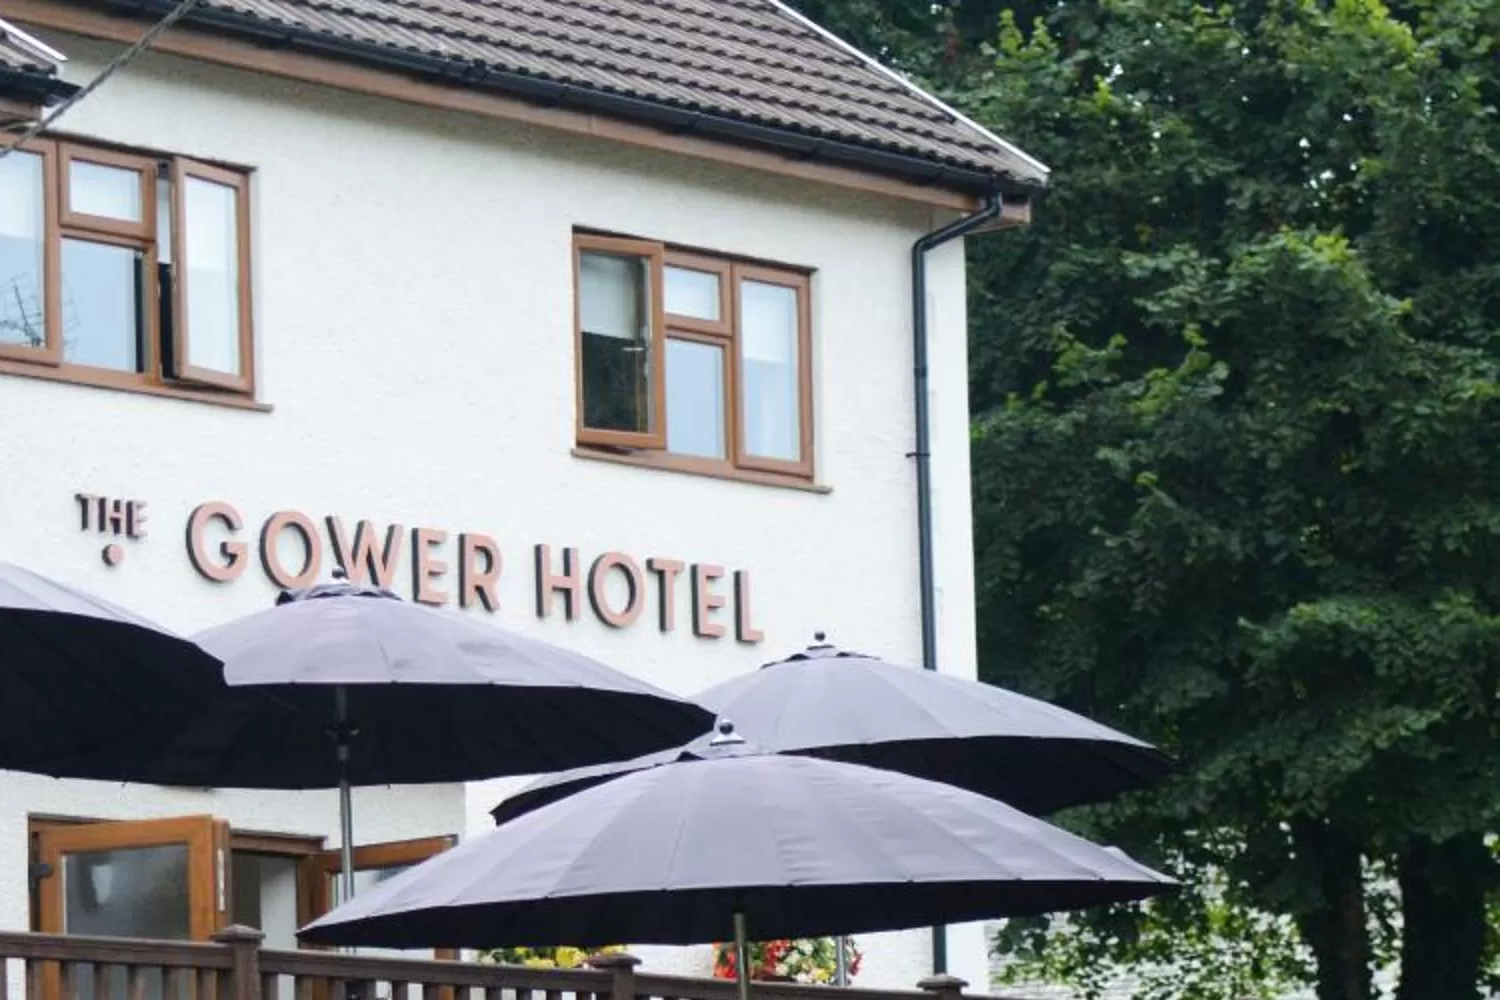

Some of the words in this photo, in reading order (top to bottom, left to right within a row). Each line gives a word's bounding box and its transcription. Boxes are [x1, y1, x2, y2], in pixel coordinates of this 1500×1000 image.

[74, 493, 148, 540] THE
[185, 500, 502, 614] GOWER
[534, 543, 765, 645] HOTEL
